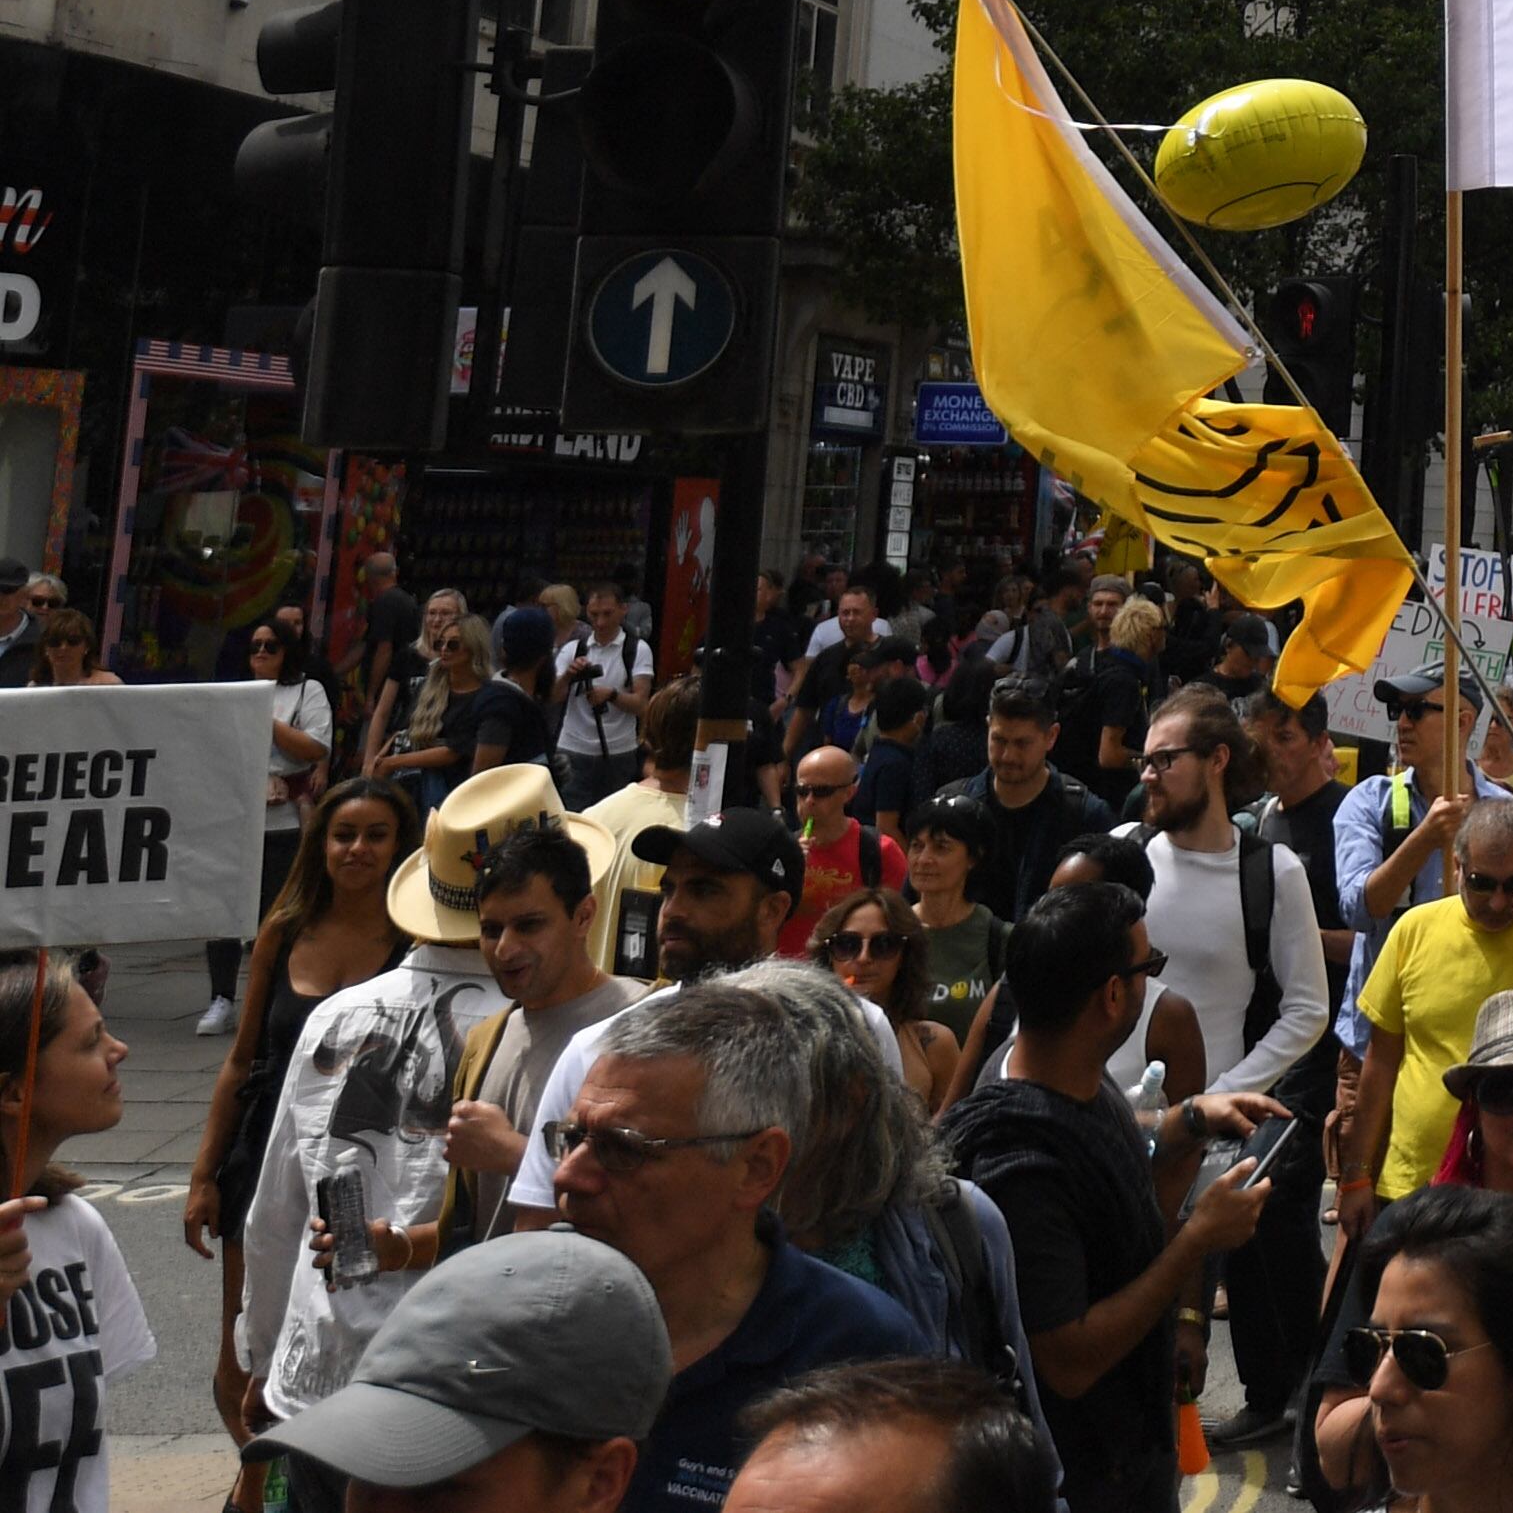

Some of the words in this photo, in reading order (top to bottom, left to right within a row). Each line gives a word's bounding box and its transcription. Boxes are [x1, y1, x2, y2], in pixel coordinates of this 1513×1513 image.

[831, 352, 875, 383] VAPE
[837, 383, 865, 408] CBD
[933, 394, 984, 409] MONE
[706, 1466, 727, 1478] and
